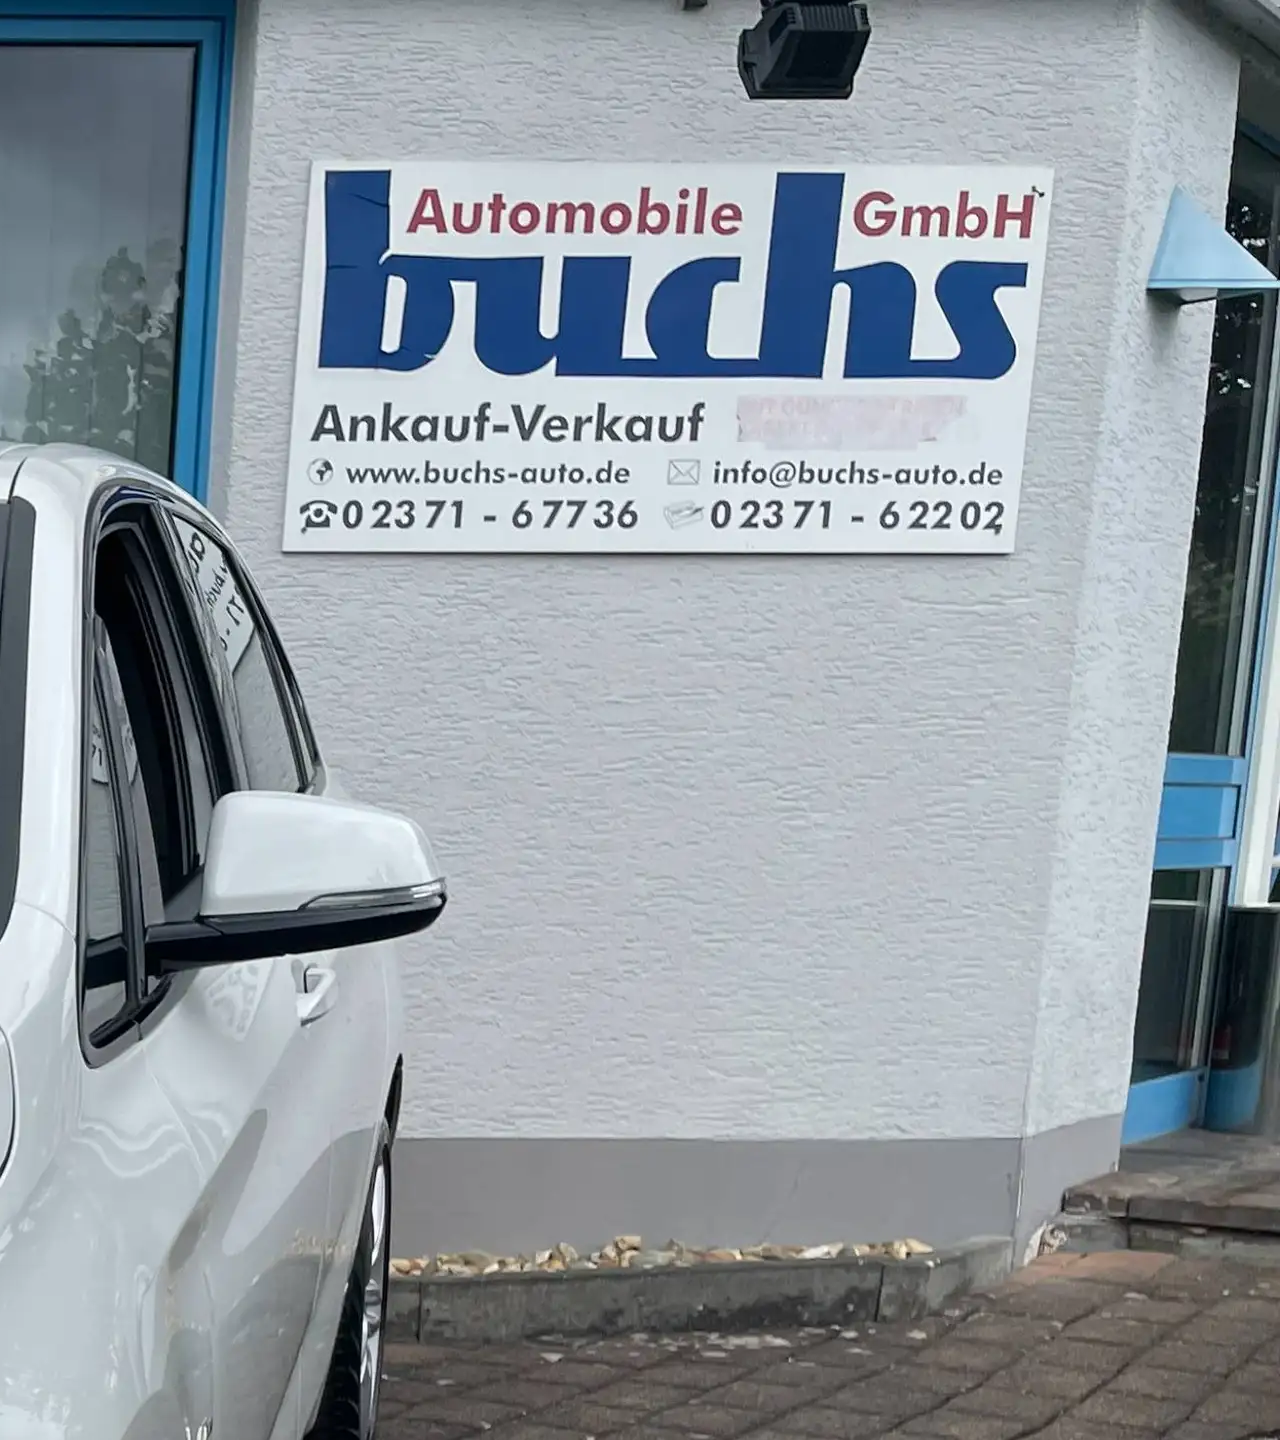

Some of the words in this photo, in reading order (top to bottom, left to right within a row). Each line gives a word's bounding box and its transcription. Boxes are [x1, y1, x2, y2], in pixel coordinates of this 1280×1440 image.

[405, 186, 744, 236] Automobile
[852, 189, 1035, 240] GmbH
[318, 169, 1028, 380] buchs
[310, 401, 706, 443] Ankauf-Verkauf
[345, 459, 631, 484] www.buchs-auto.de
[713, 461, 1003, 488] info@buchs-auto.de
